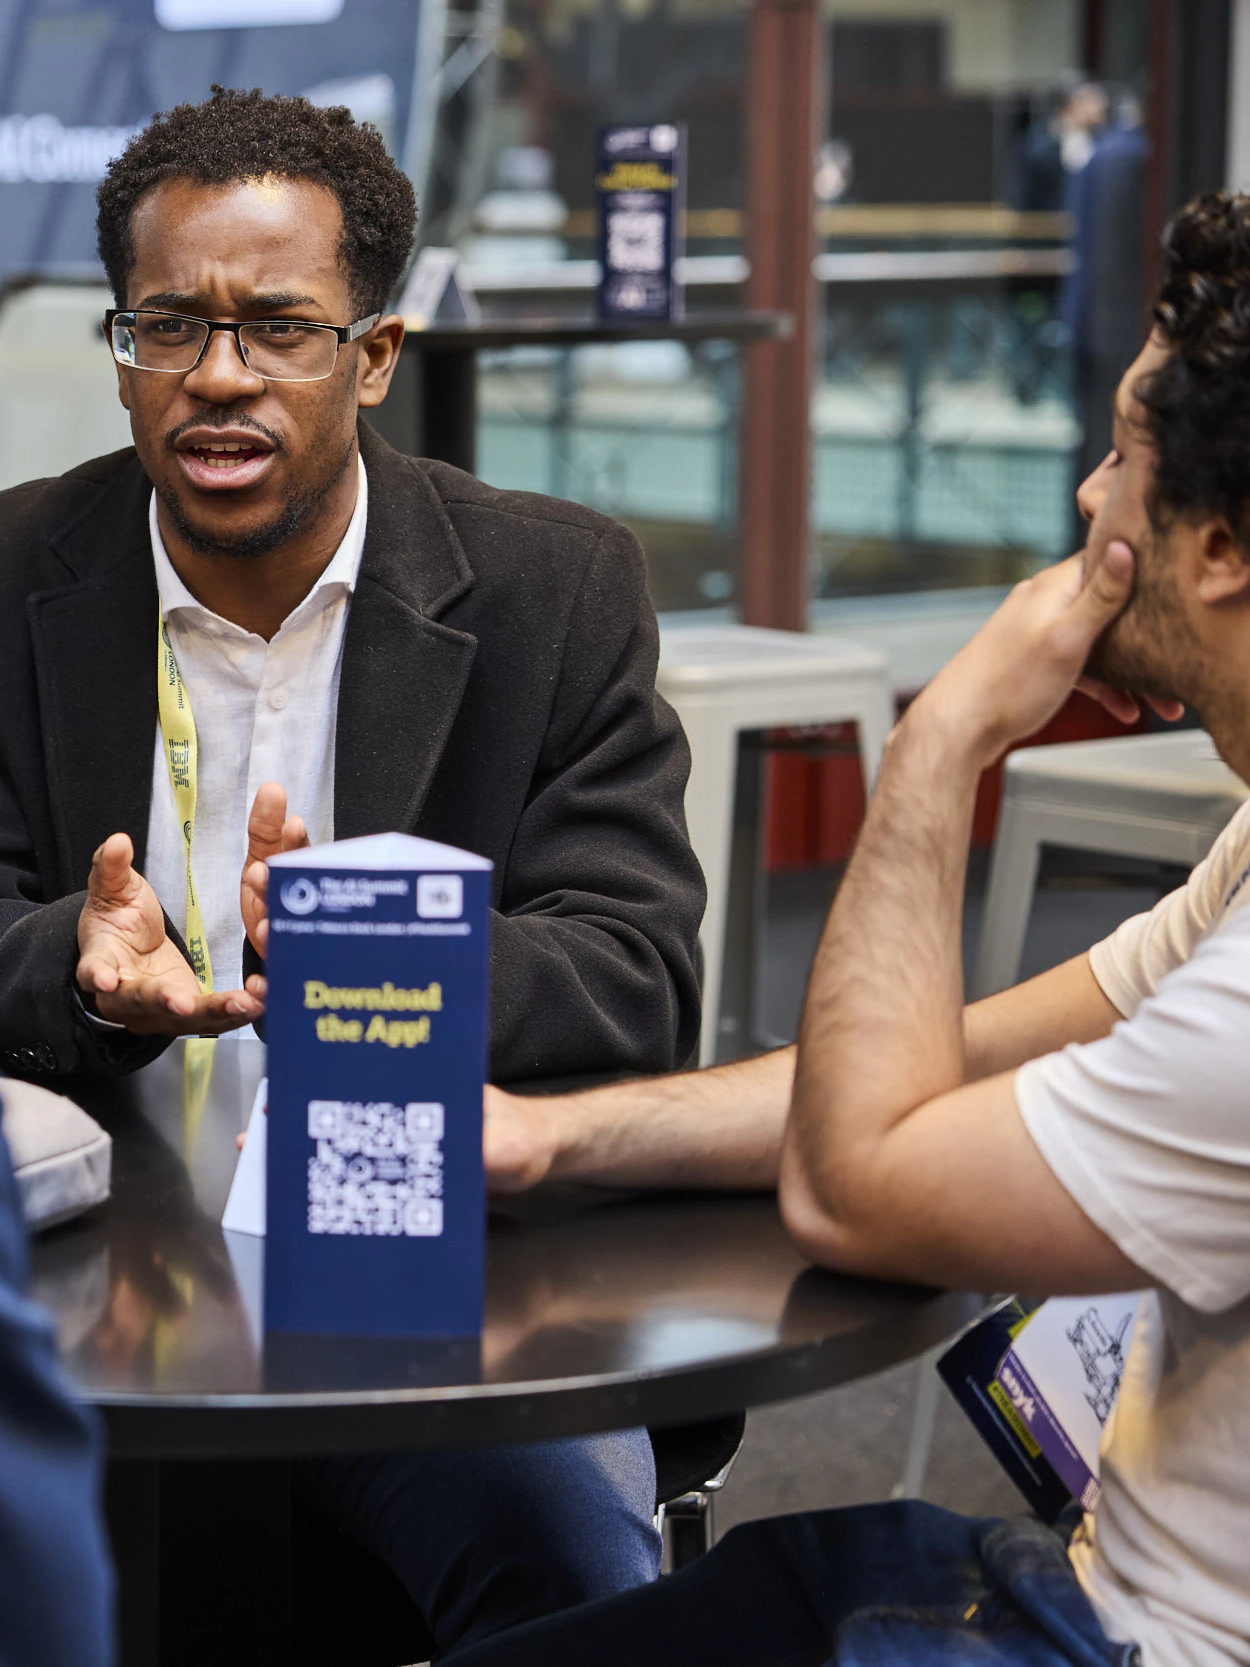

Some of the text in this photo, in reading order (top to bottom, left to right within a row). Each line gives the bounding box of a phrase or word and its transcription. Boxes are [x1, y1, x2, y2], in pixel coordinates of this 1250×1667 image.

[168, 651, 176, 686] LONDON
[168, 738, 190, 788] IBM
[304, 981, 442, 1012] Download
[316, 1013, 431, 1048] the App!
